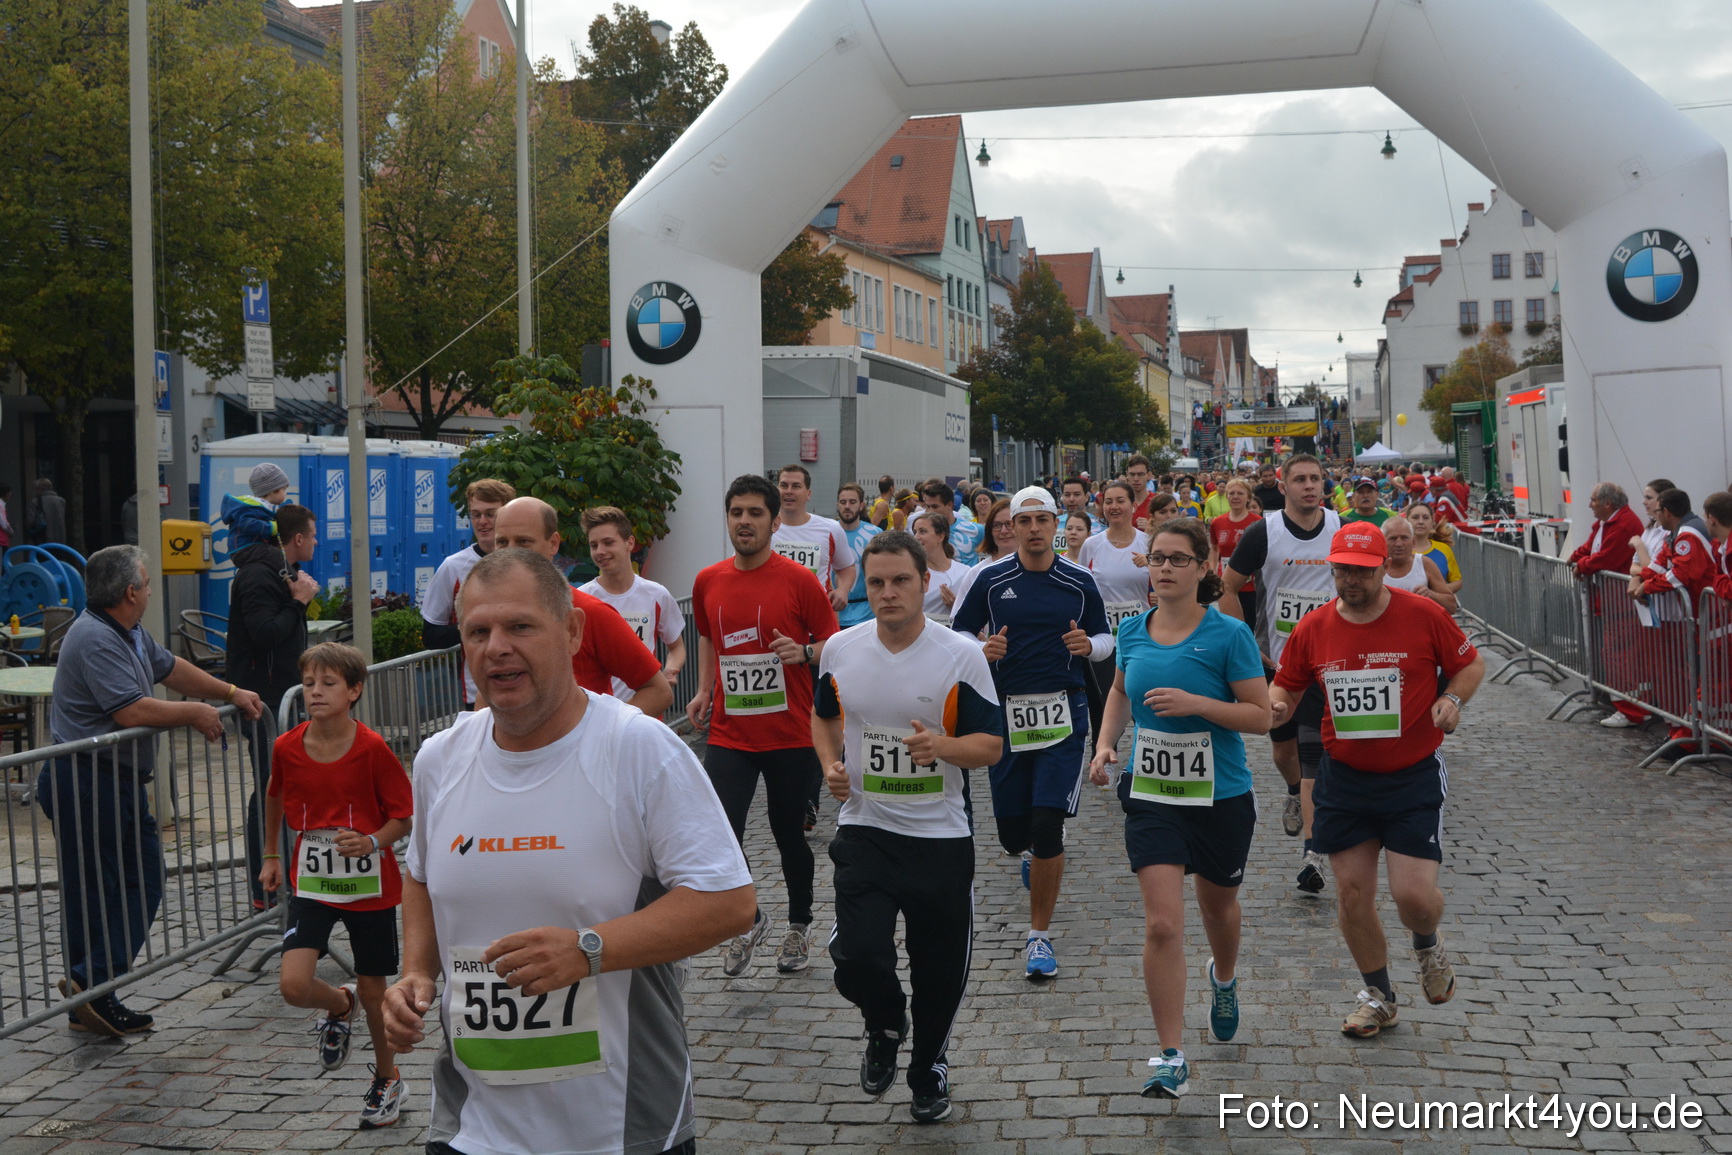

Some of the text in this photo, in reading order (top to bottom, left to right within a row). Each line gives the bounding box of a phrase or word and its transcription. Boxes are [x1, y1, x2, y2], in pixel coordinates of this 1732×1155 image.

[1613, 231, 1691, 264] BMW
[250, 283, 263, 316] P
[631, 283, 695, 311] BMW
[1255, 425, 1287, 434] START
[191, 434, 199, 453] 3
[327, 473, 344, 500] DIXI
[370, 473, 387, 498] DIXI
[415, 474, 434, 497] DIXI
[1277, 592, 1296, 600] PARTL
[1280, 600, 1324, 620] 514
[733, 633, 749, 642] DEHN
[726, 667, 779, 692] 5122
[1326, 675, 1386, 685] PARTL Neumarkt
[742, 697, 764, 706] Saad
[1333, 685, 1390, 713] 5551
[1012, 703, 1065, 729] 5012
[863, 732, 890, 742] PARTL
[1027, 731, 1055, 742] Marius
[1138, 734, 1198, 748] PARTL Neumarkt
[1141, 747, 1207, 777] 5014
[880, 779, 925, 792] Andreas
[1160, 782, 1185, 794] Lena
[303, 834, 324, 844] PARTL
[478, 835, 566, 852] KLEBL
[320, 880, 357, 892] Florian
[454, 960, 494, 973] PARTL
[464, 981, 580, 1032] 5527
